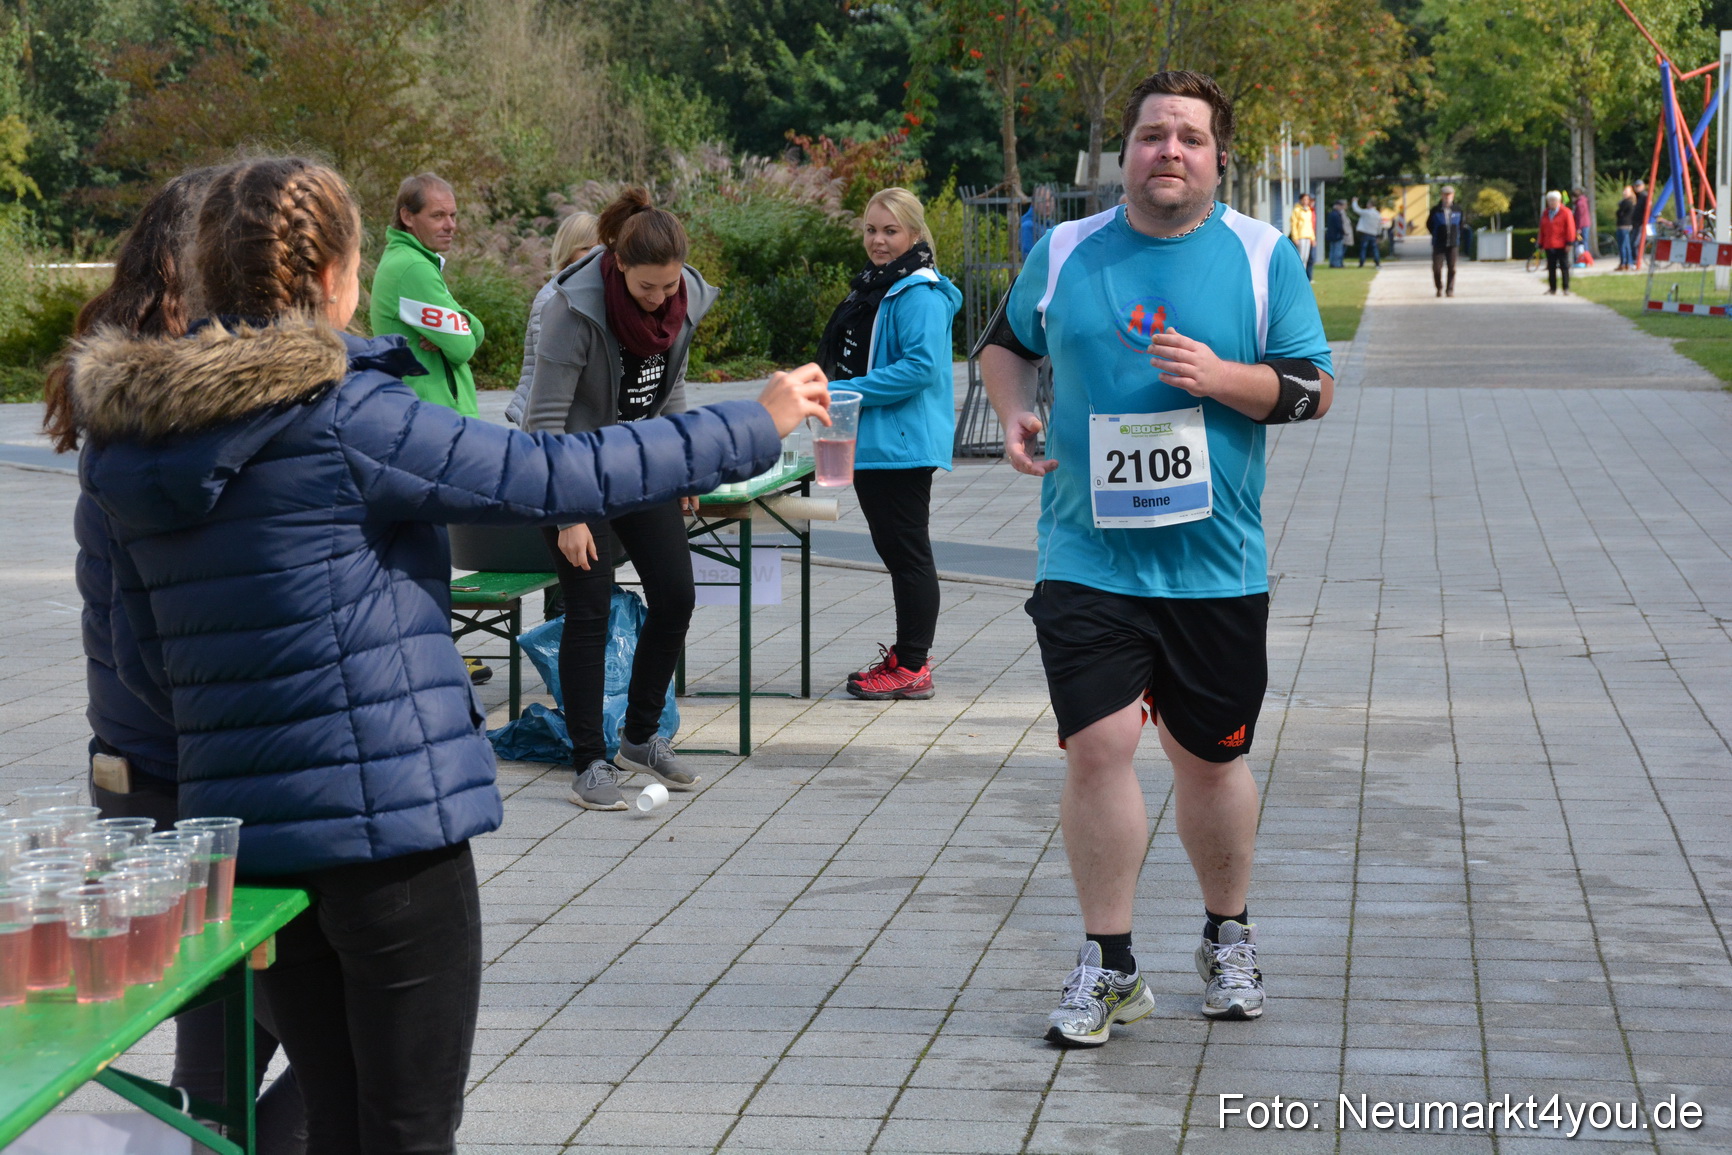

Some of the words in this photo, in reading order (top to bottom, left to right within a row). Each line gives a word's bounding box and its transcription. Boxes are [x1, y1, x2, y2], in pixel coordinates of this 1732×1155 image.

[1131, 422, 1172, 434] BOCK
[1106, 445, 1192, 484] 2108
[1132, 496, 1171, 508] Benne
